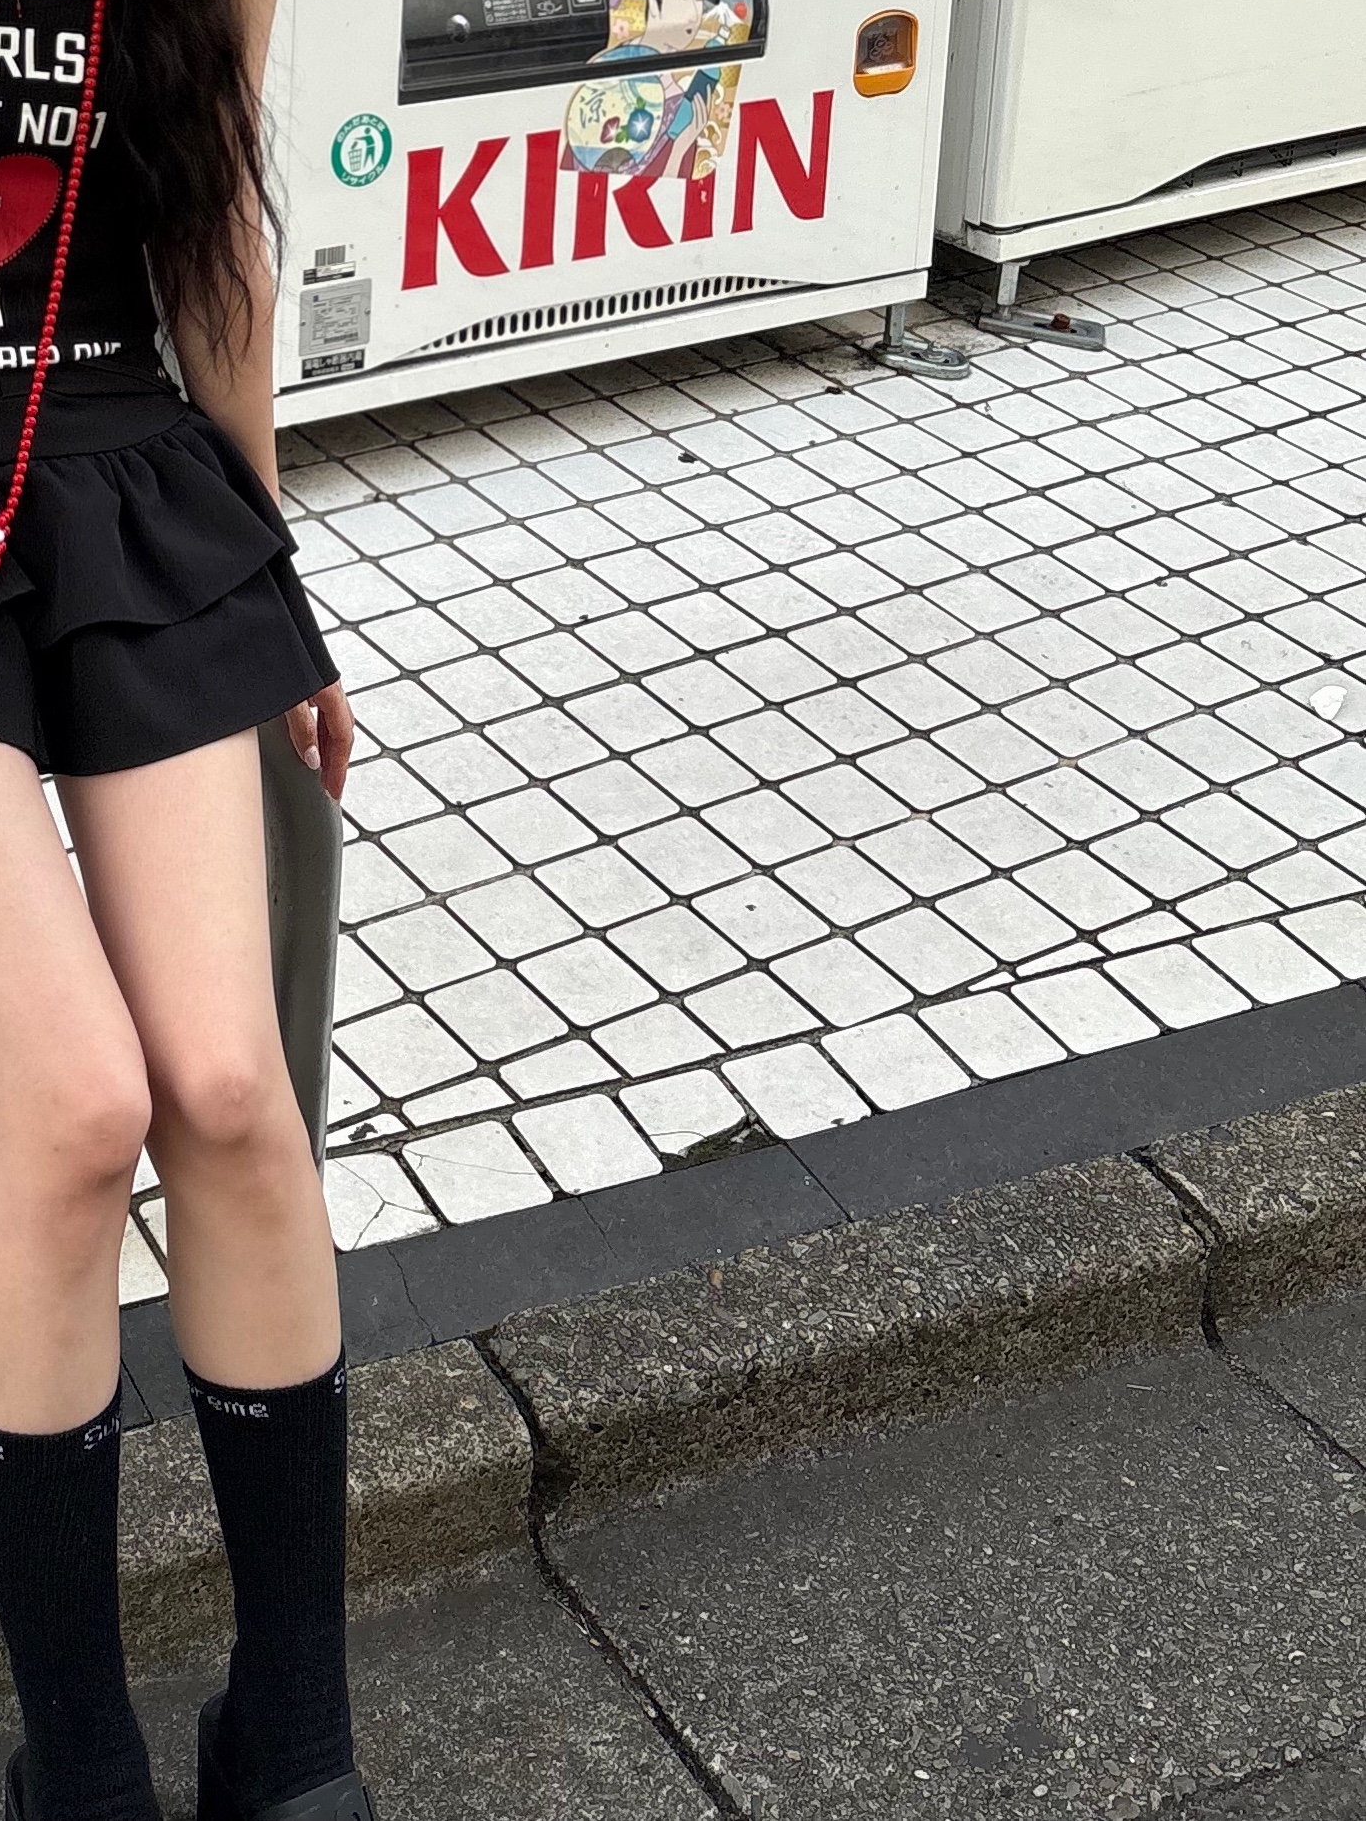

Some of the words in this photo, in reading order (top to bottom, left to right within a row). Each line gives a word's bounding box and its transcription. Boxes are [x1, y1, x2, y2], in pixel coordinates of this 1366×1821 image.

[17, 101, 79, 147] NO
[89, 111, 107, 150] 1
[401, 89, 835, 291] KIRIN
